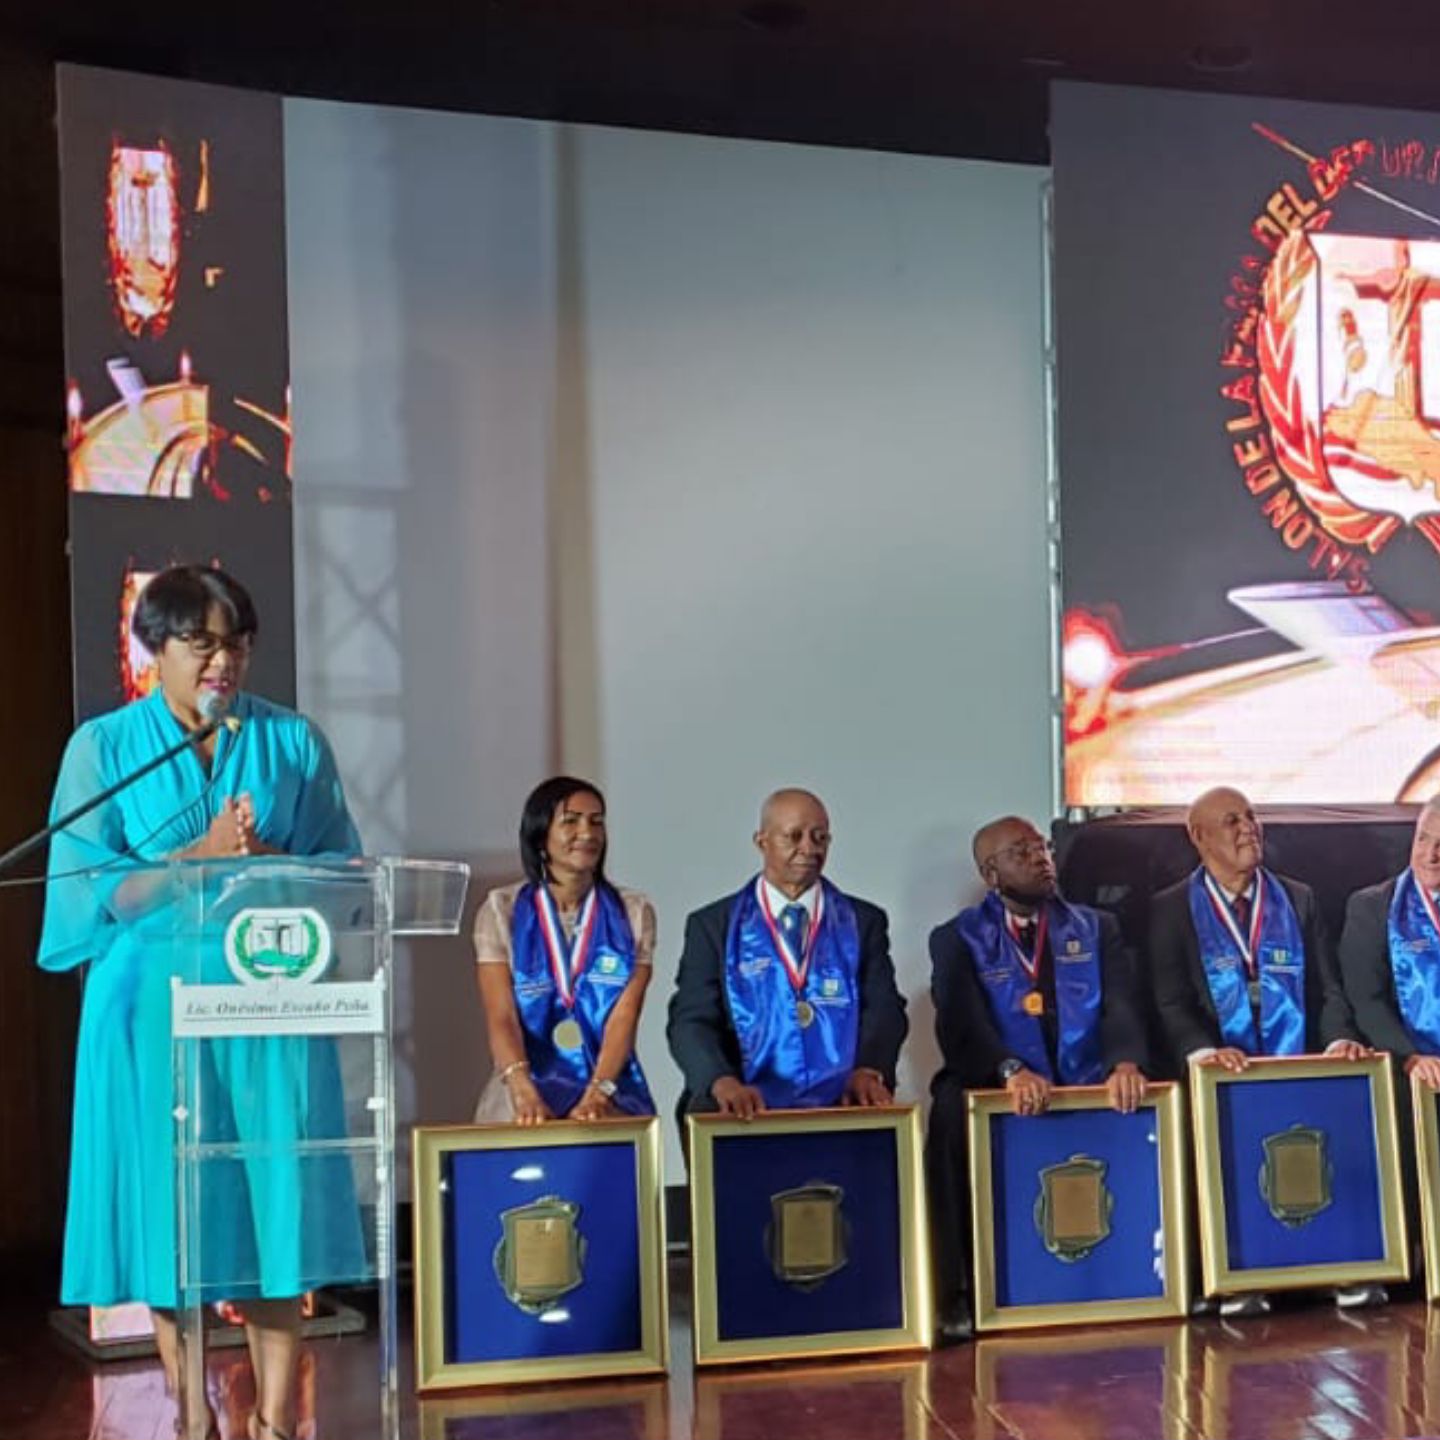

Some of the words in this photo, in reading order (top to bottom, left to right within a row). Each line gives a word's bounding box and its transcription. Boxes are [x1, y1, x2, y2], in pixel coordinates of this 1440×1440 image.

[1251, 183, 1318, 251] DEL
[1220, 374, 1261, 432] LA
[1233, 432, 1281, 495] DE
